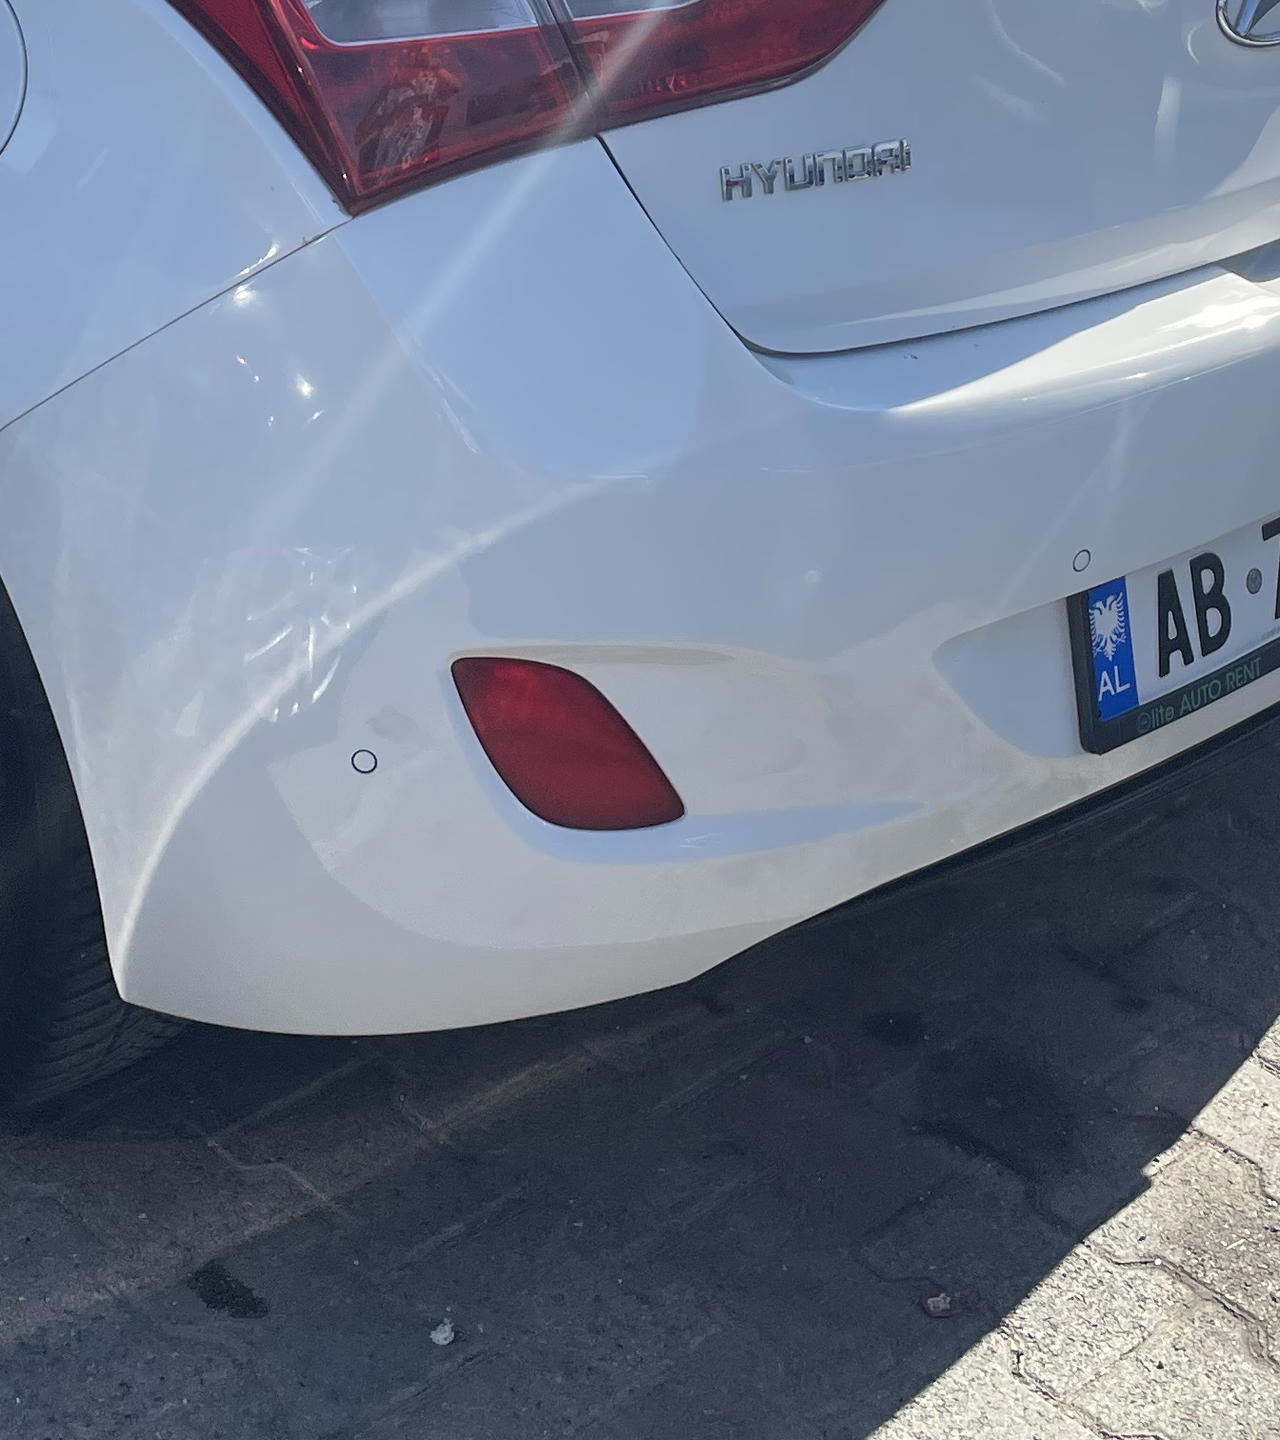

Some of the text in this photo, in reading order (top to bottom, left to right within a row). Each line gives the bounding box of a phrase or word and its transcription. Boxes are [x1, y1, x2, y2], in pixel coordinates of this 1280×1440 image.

[720, 137, 911, 200] HYUNDAI
[1158, 552, 1232, 678] AB
[1098, 665, 1130, 701] AL
[1179, 679, 1222, 717] AUTO
[1225, 657, 1262, 693] RENT
